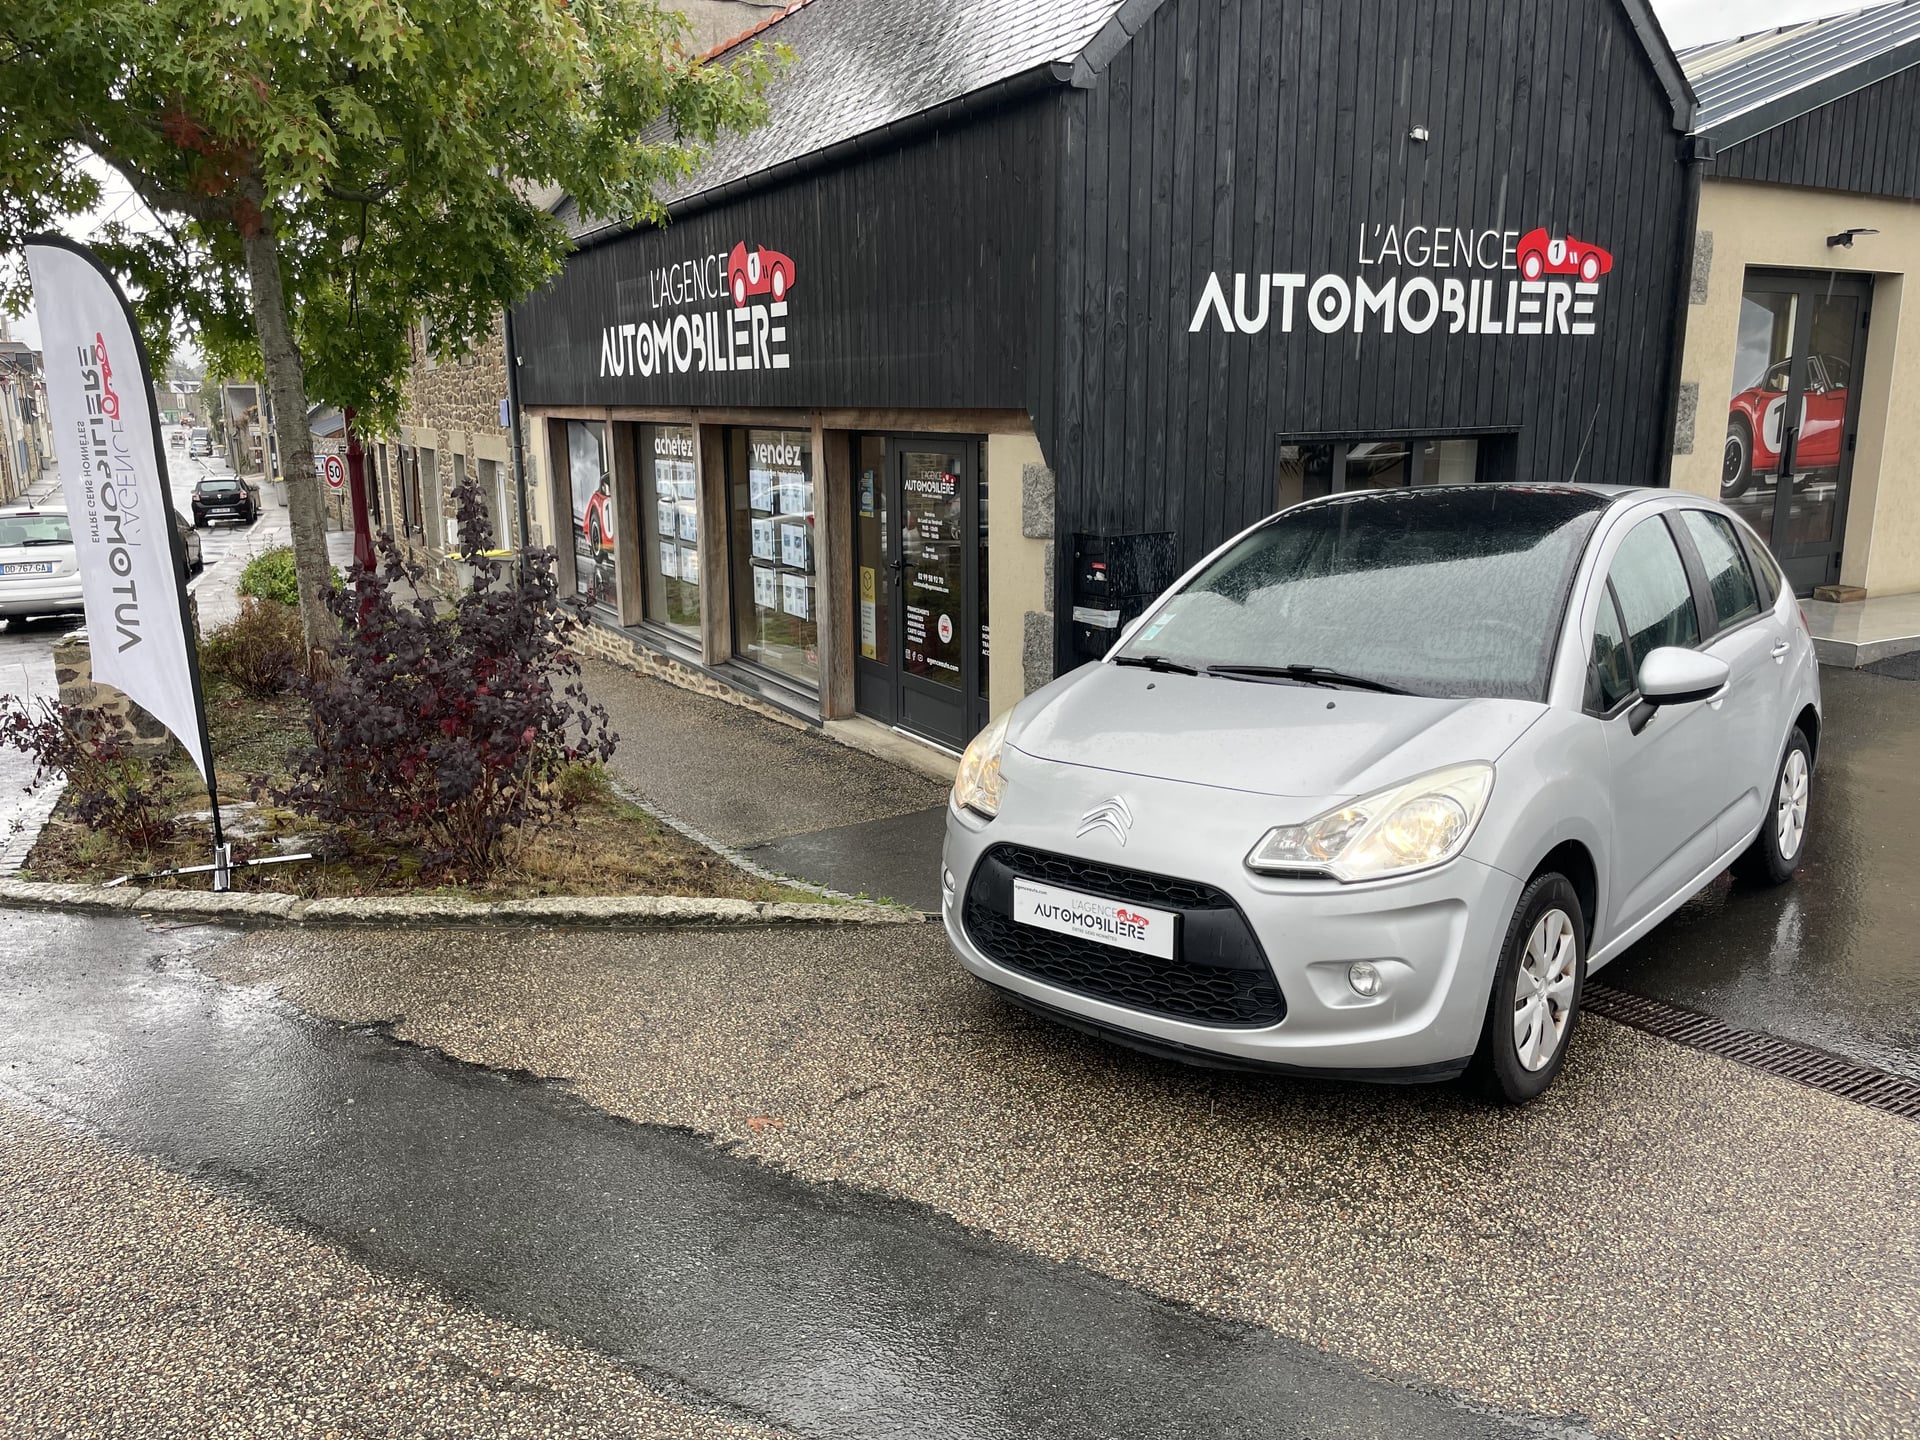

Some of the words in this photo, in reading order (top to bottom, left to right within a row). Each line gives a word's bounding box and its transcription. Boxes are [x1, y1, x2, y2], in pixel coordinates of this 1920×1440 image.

[1358, 222, 1519, 270] L'AGENCE
[1554, 242, 1560, 259] 1
[650, 252, 730, 309] L'AGENCE
[655, 428, 693, 457] achetez
[752, 432, 802, 466] vendez
[329, 465, 340, 478] 50
[1071, 898, 1118, 918] L'AGENCE
